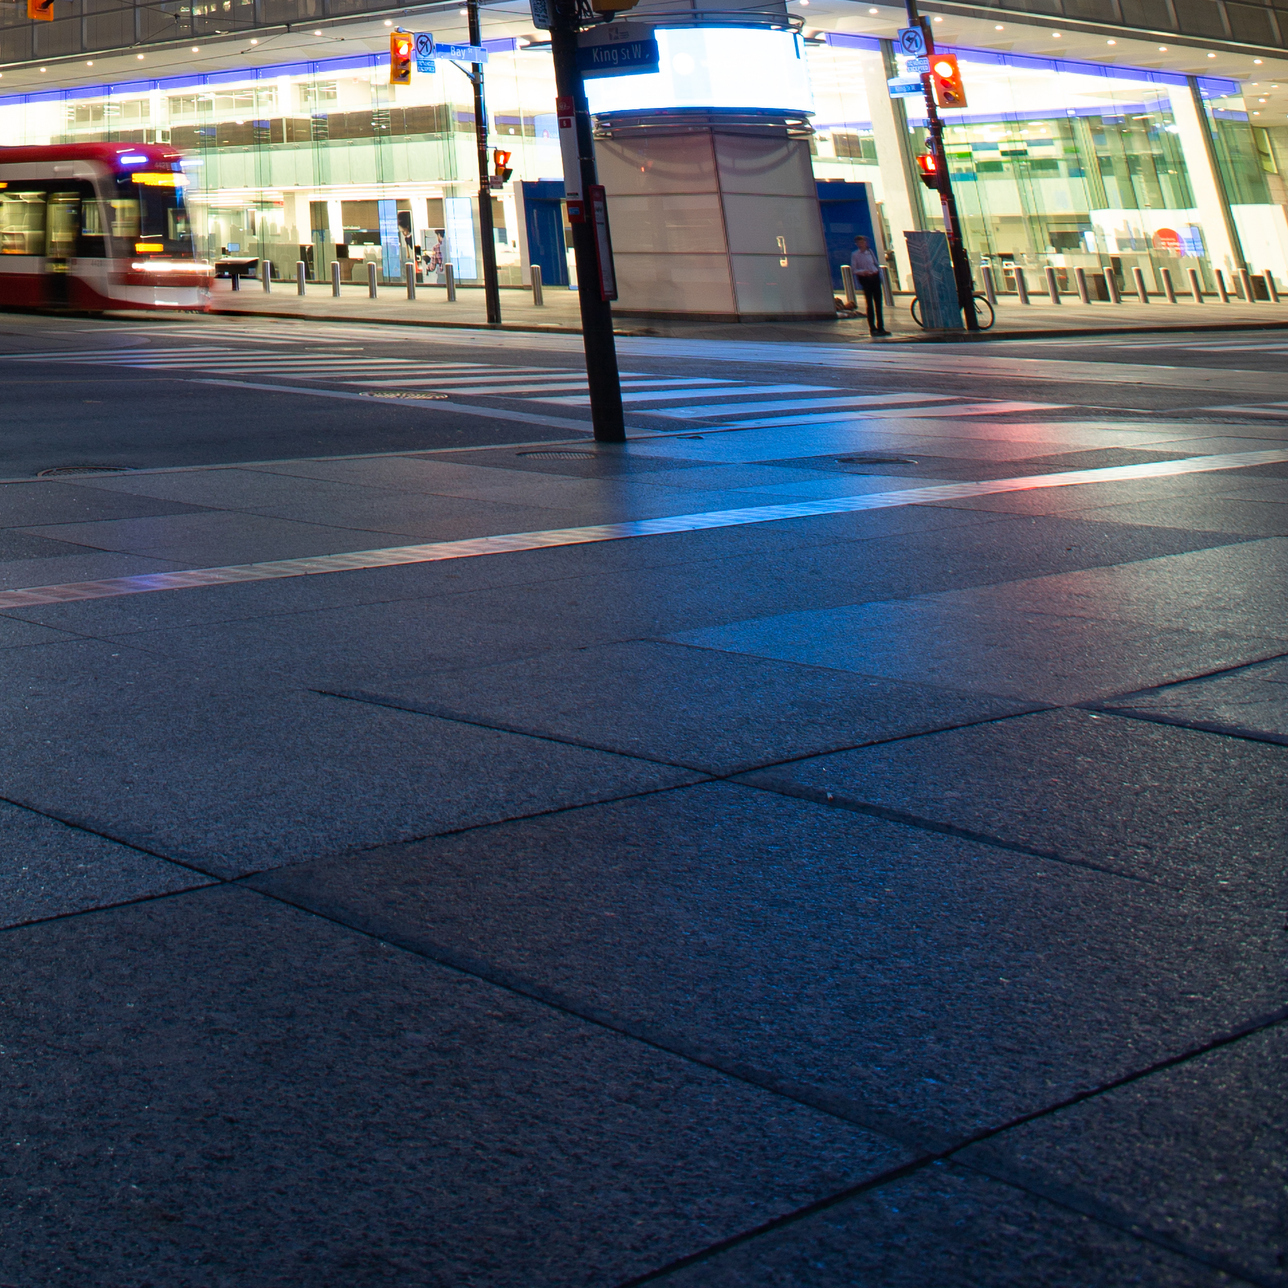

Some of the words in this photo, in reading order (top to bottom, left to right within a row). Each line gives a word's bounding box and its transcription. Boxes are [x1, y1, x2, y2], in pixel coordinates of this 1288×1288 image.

[450, 46, 466, 59] Bay
[592, 47, 619, 65] King
[621, 46, 631, 60] St
[631, 44, 642, 59] W
